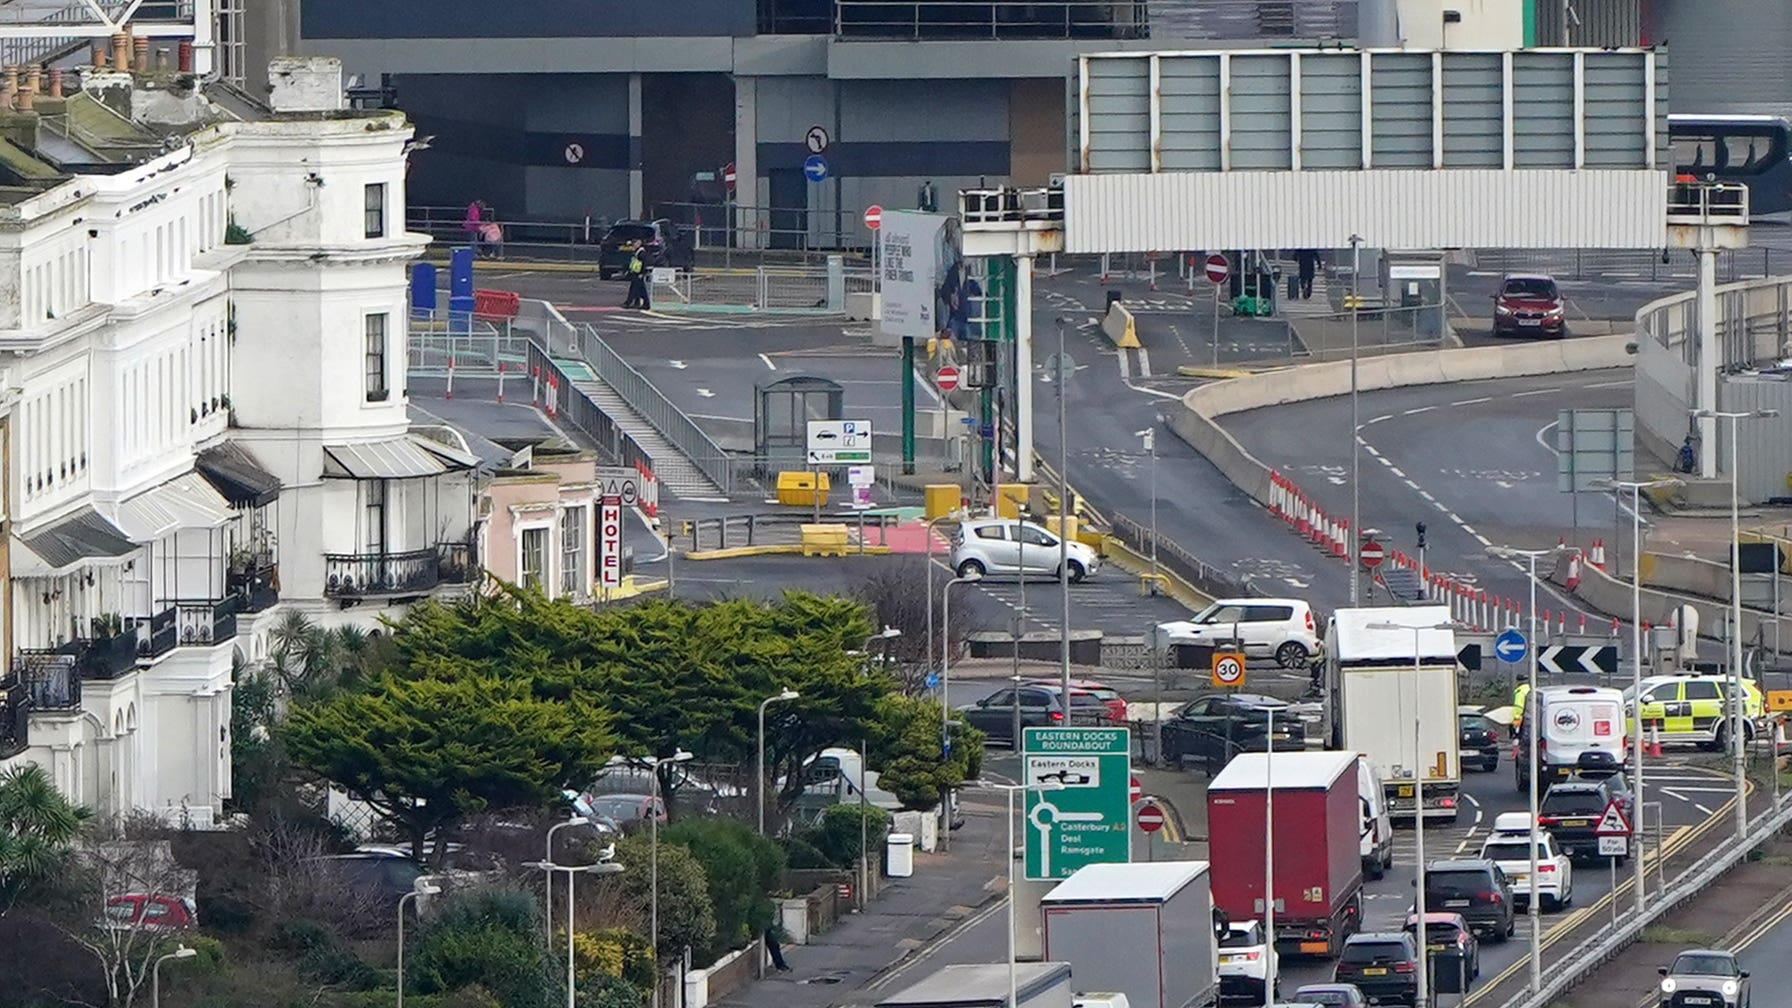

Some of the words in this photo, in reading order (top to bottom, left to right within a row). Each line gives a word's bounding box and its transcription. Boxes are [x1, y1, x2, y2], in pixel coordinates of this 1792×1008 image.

[604, 509, 618, 583] HOTEL
[1219, 663, 1238, 676] 30
[1035, 732, 1081, 741] EASTERN
[1082, 732, 1117, 741] DOCKS
[1042, 741, 1112, 750] ROUNDABOUT
[1031, 760, 1066, 768] Eastern
[1068, 760, 1096, 768] Docks
[1060, 822, 1110, 832] Canterbury
[1112, 822, 1127, 831] A2
[1060, 834, 1082, 843] Deal
[1060, 846, 1105, 856] Ramsgate
